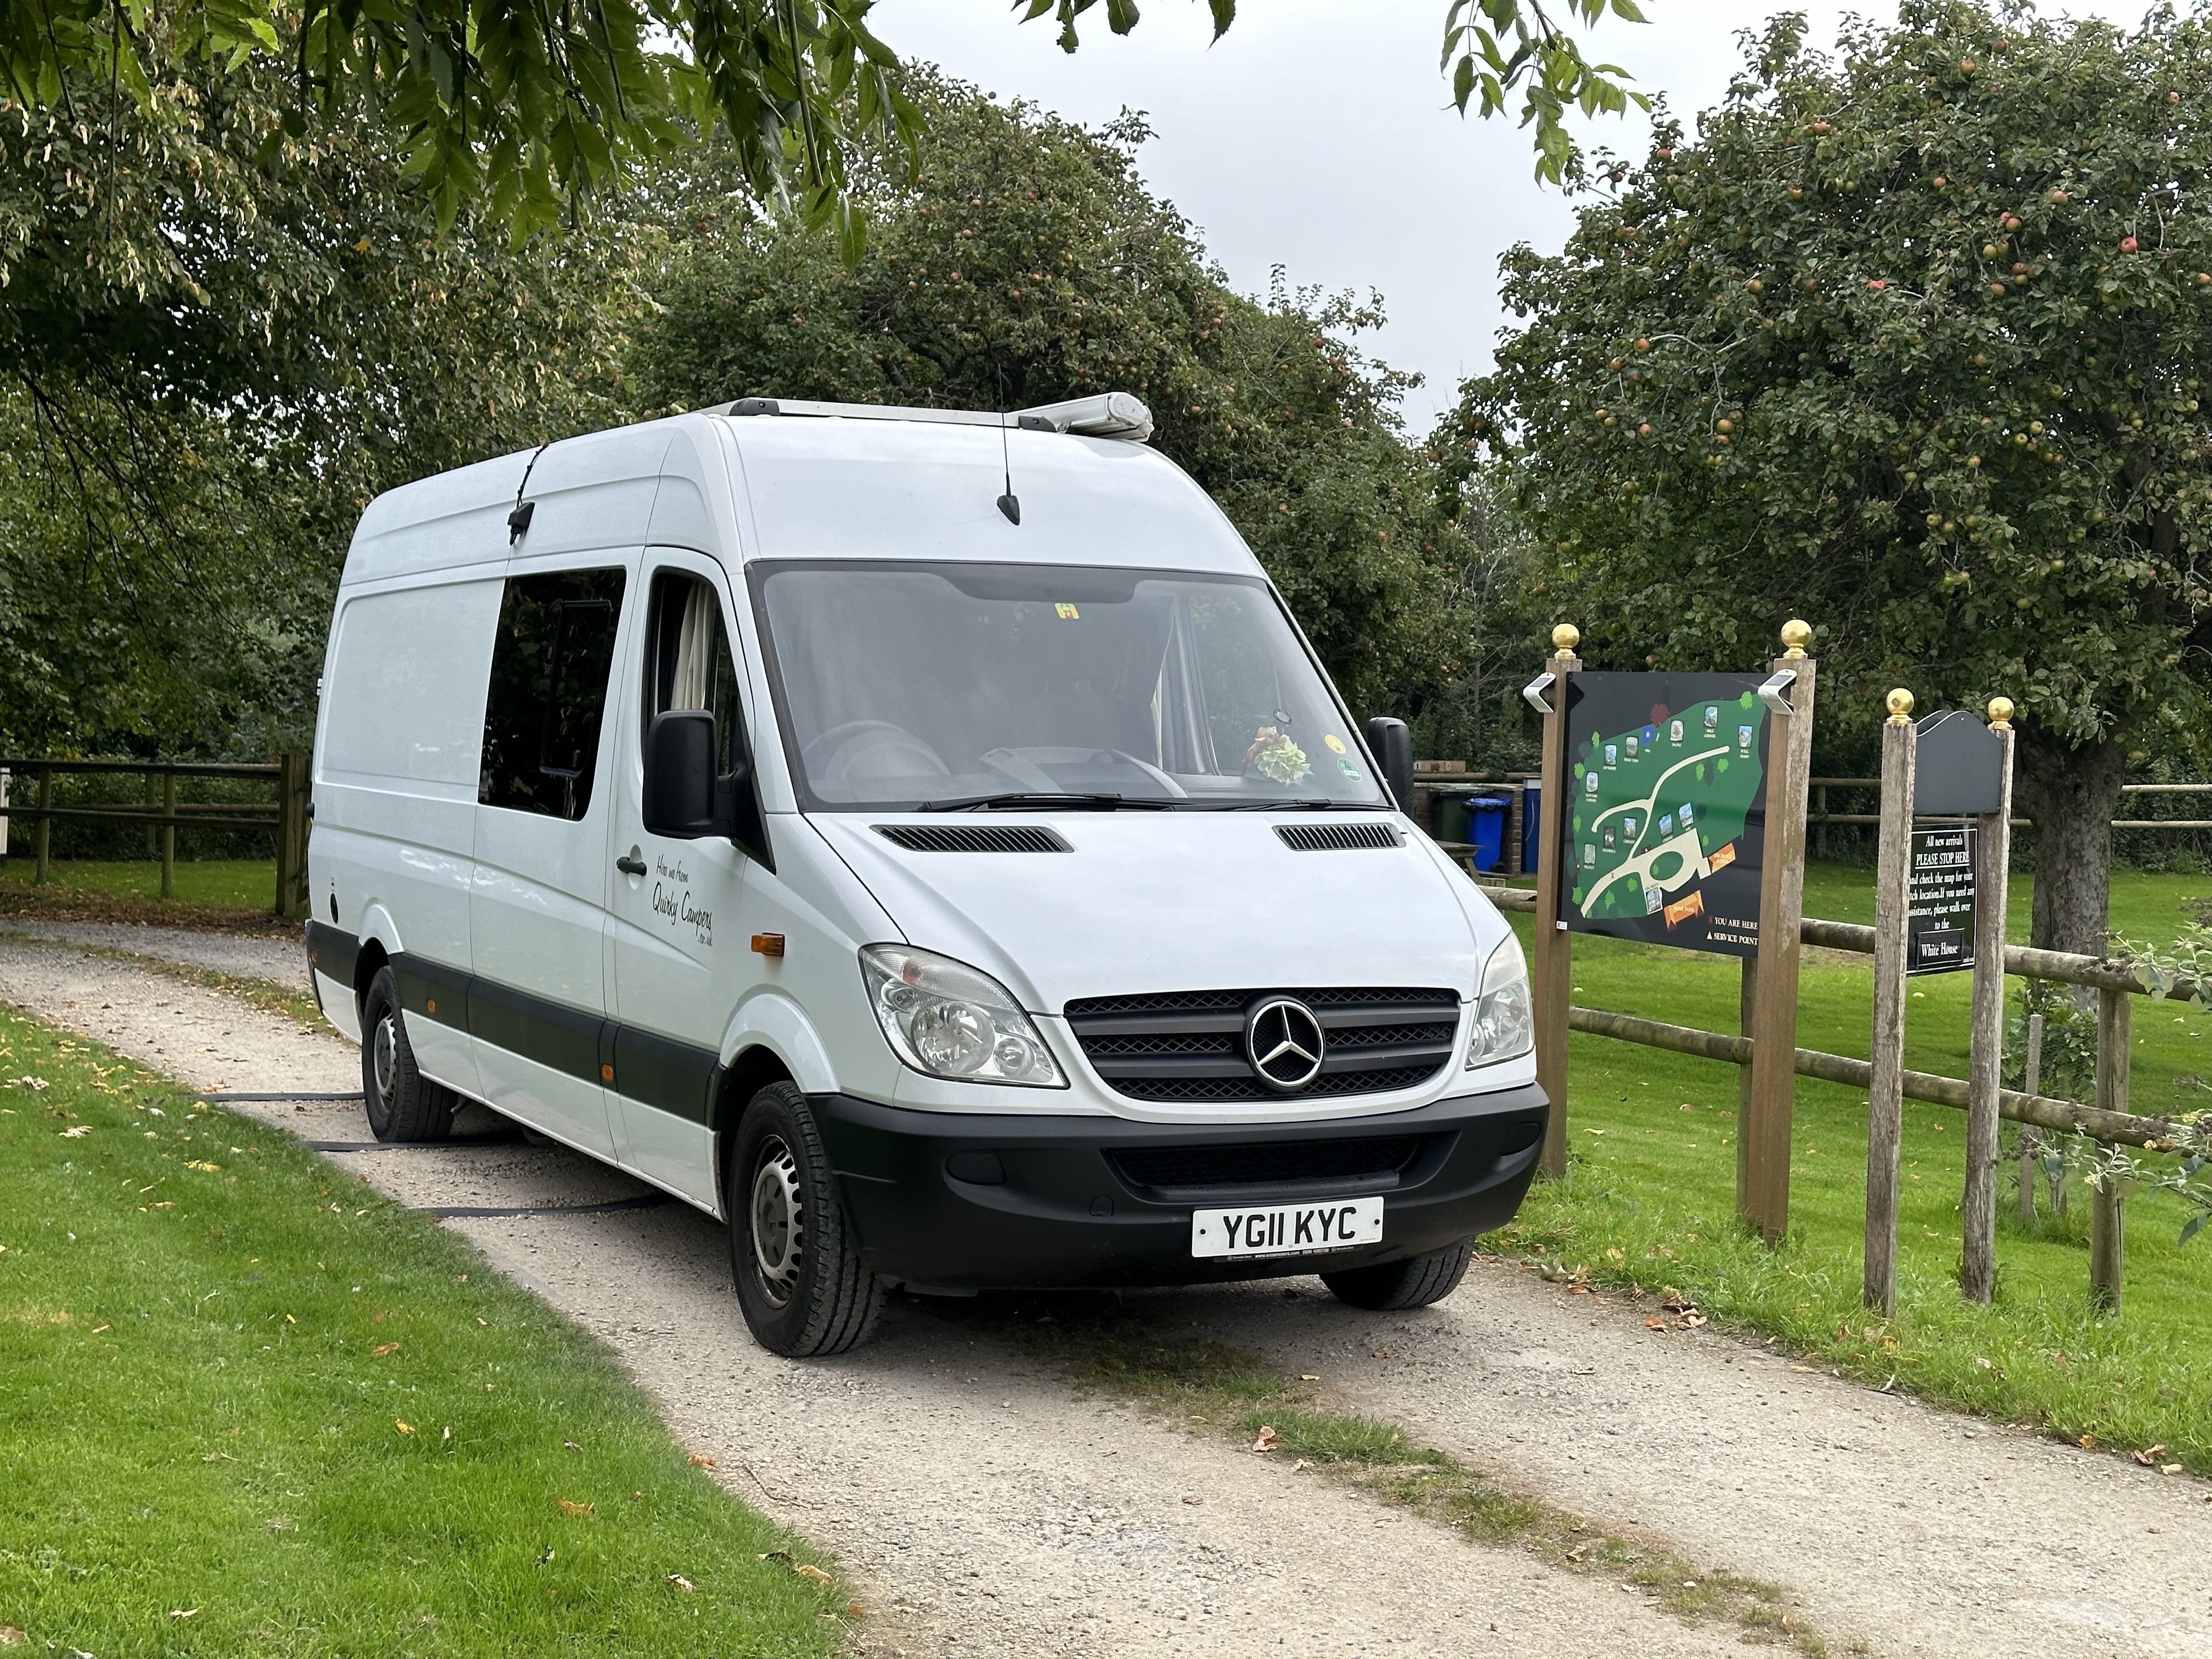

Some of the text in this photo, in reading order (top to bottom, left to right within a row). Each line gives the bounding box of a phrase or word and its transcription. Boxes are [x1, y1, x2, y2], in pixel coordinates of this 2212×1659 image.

[1926, 834, 1963, 847] All new arrivals
[1916, 850, 1970, 866] PLEASE STOP HERE
[656, 854, 668, 877] Hire
[675, 860, 689, 883] from
[1920, 872, 1934, 884] check
[1935, 871, 1943, 883] the
[1944, 874, 1955, 884] map
[1963, 873, 1973, 883] your
[1946, 890, 1955, 900] you
[1956, 885, 1966, 897] need
[653, 881, 712, 936] Quirky Campers
[1909, 900, 1971, 917] ssistance, please walk over
[1714, 916, 1727, 926] YOU
[1728, 919, 1741, 928] ARE
[1742, 920, 1758, 930] HERE
[1941, 917, 1950, 929] the
[697, 931, 713, 947] .co.uk
[1713, 932, 1759, 946] SERVICE POINT
[1921, 941, 1958, 957] White House
[1223, 1206, 1357, 1249] YG11 KYC
